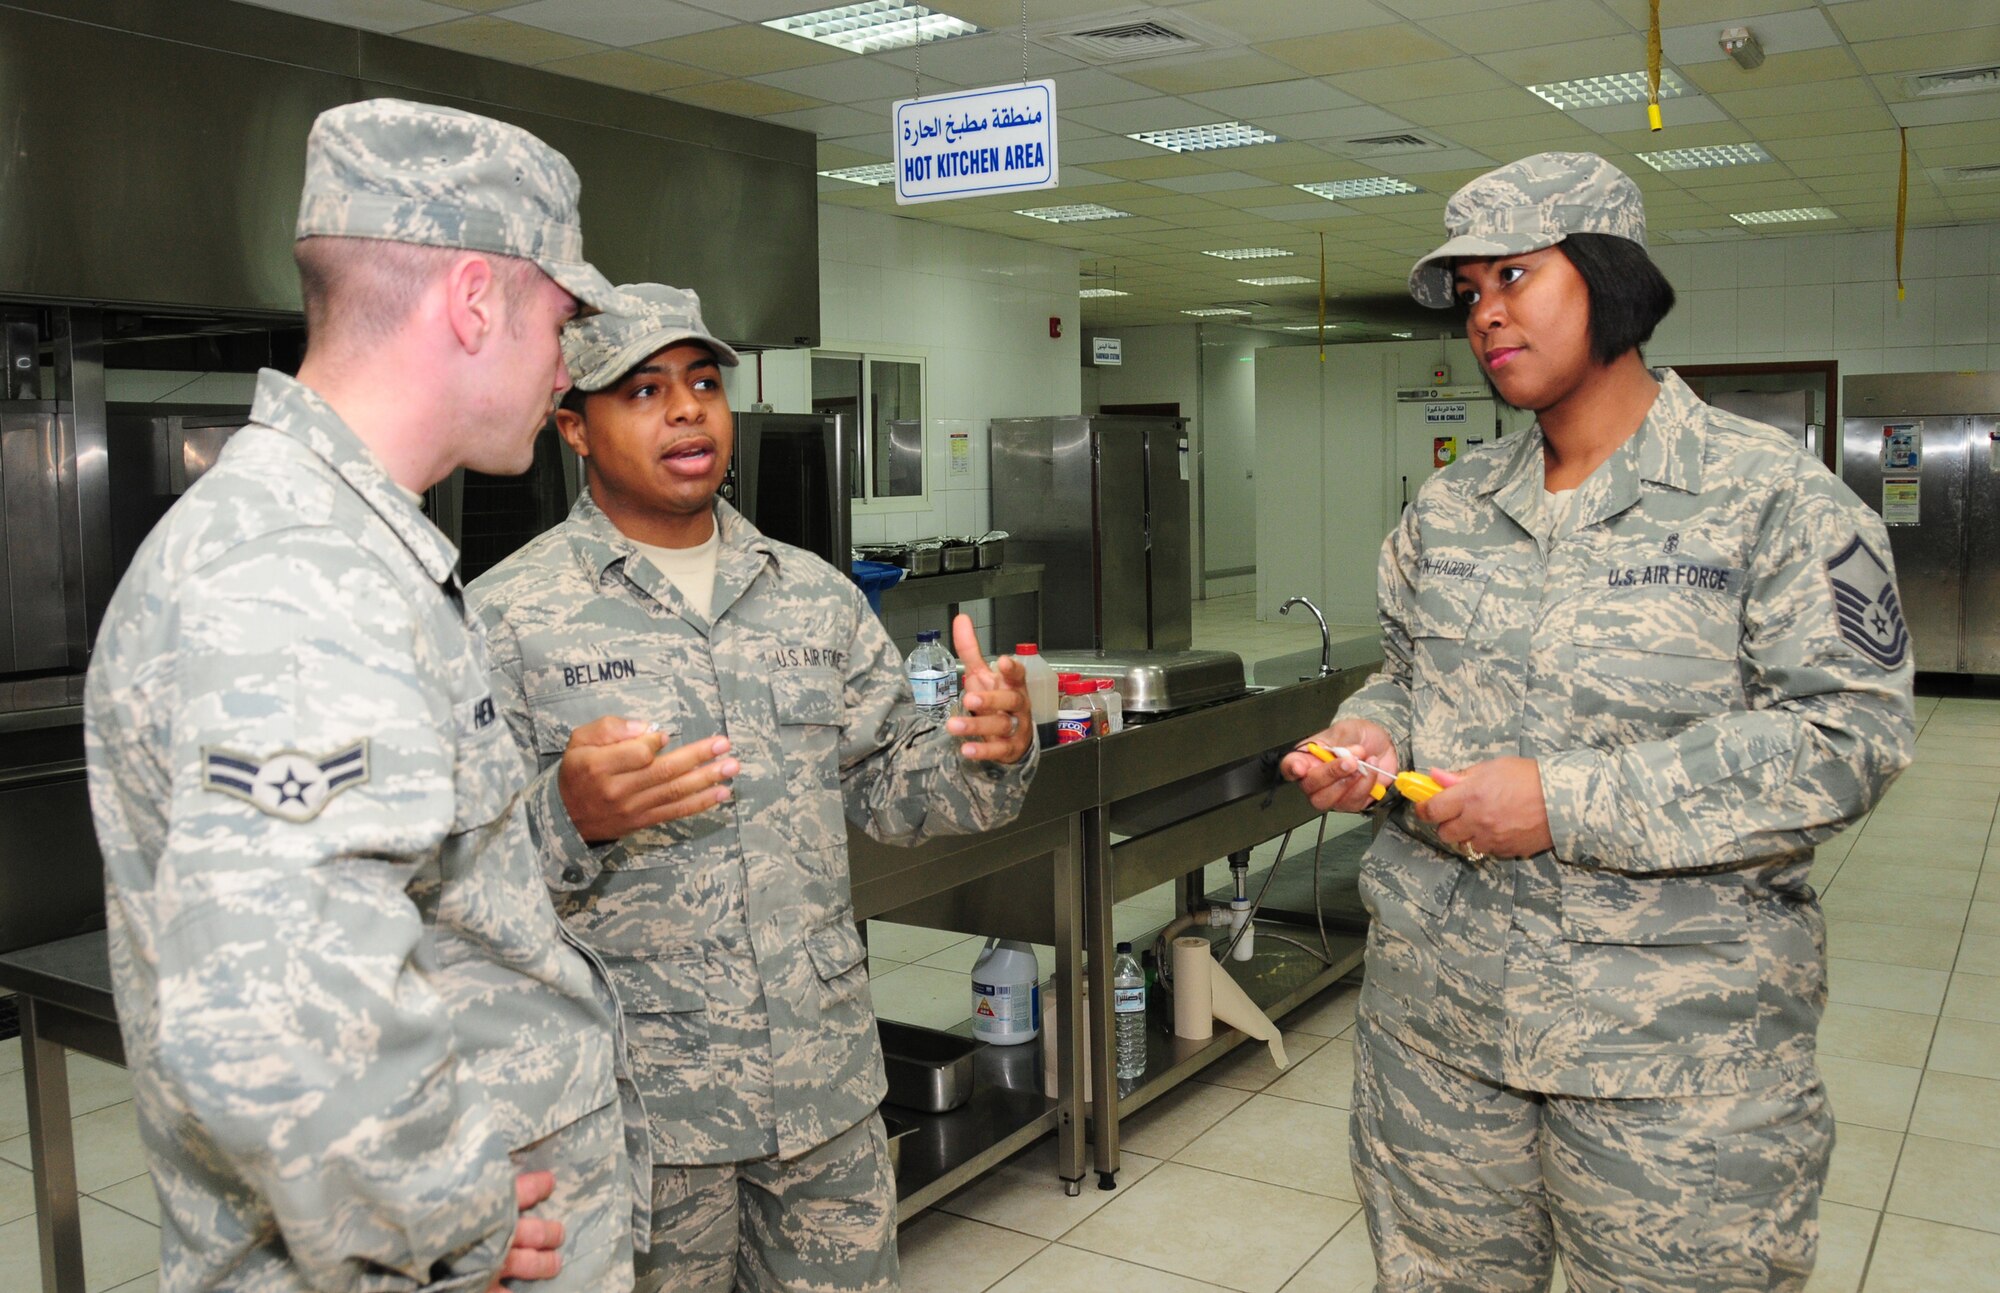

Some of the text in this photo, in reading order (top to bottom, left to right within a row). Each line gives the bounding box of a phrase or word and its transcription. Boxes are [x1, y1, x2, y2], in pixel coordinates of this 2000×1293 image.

[904, 106, 1042, 146] منطقة مطبخ الحارة
[905, 142, 1045, 182] HOT KITCHEN AREA
[1608, 564, 1730, 590] U.S. AIR FORCE
[776, 649, 802, 668] U.S.
[804, 647, 820, 667] AIR
[563, 659, 636, 687] BELMON
